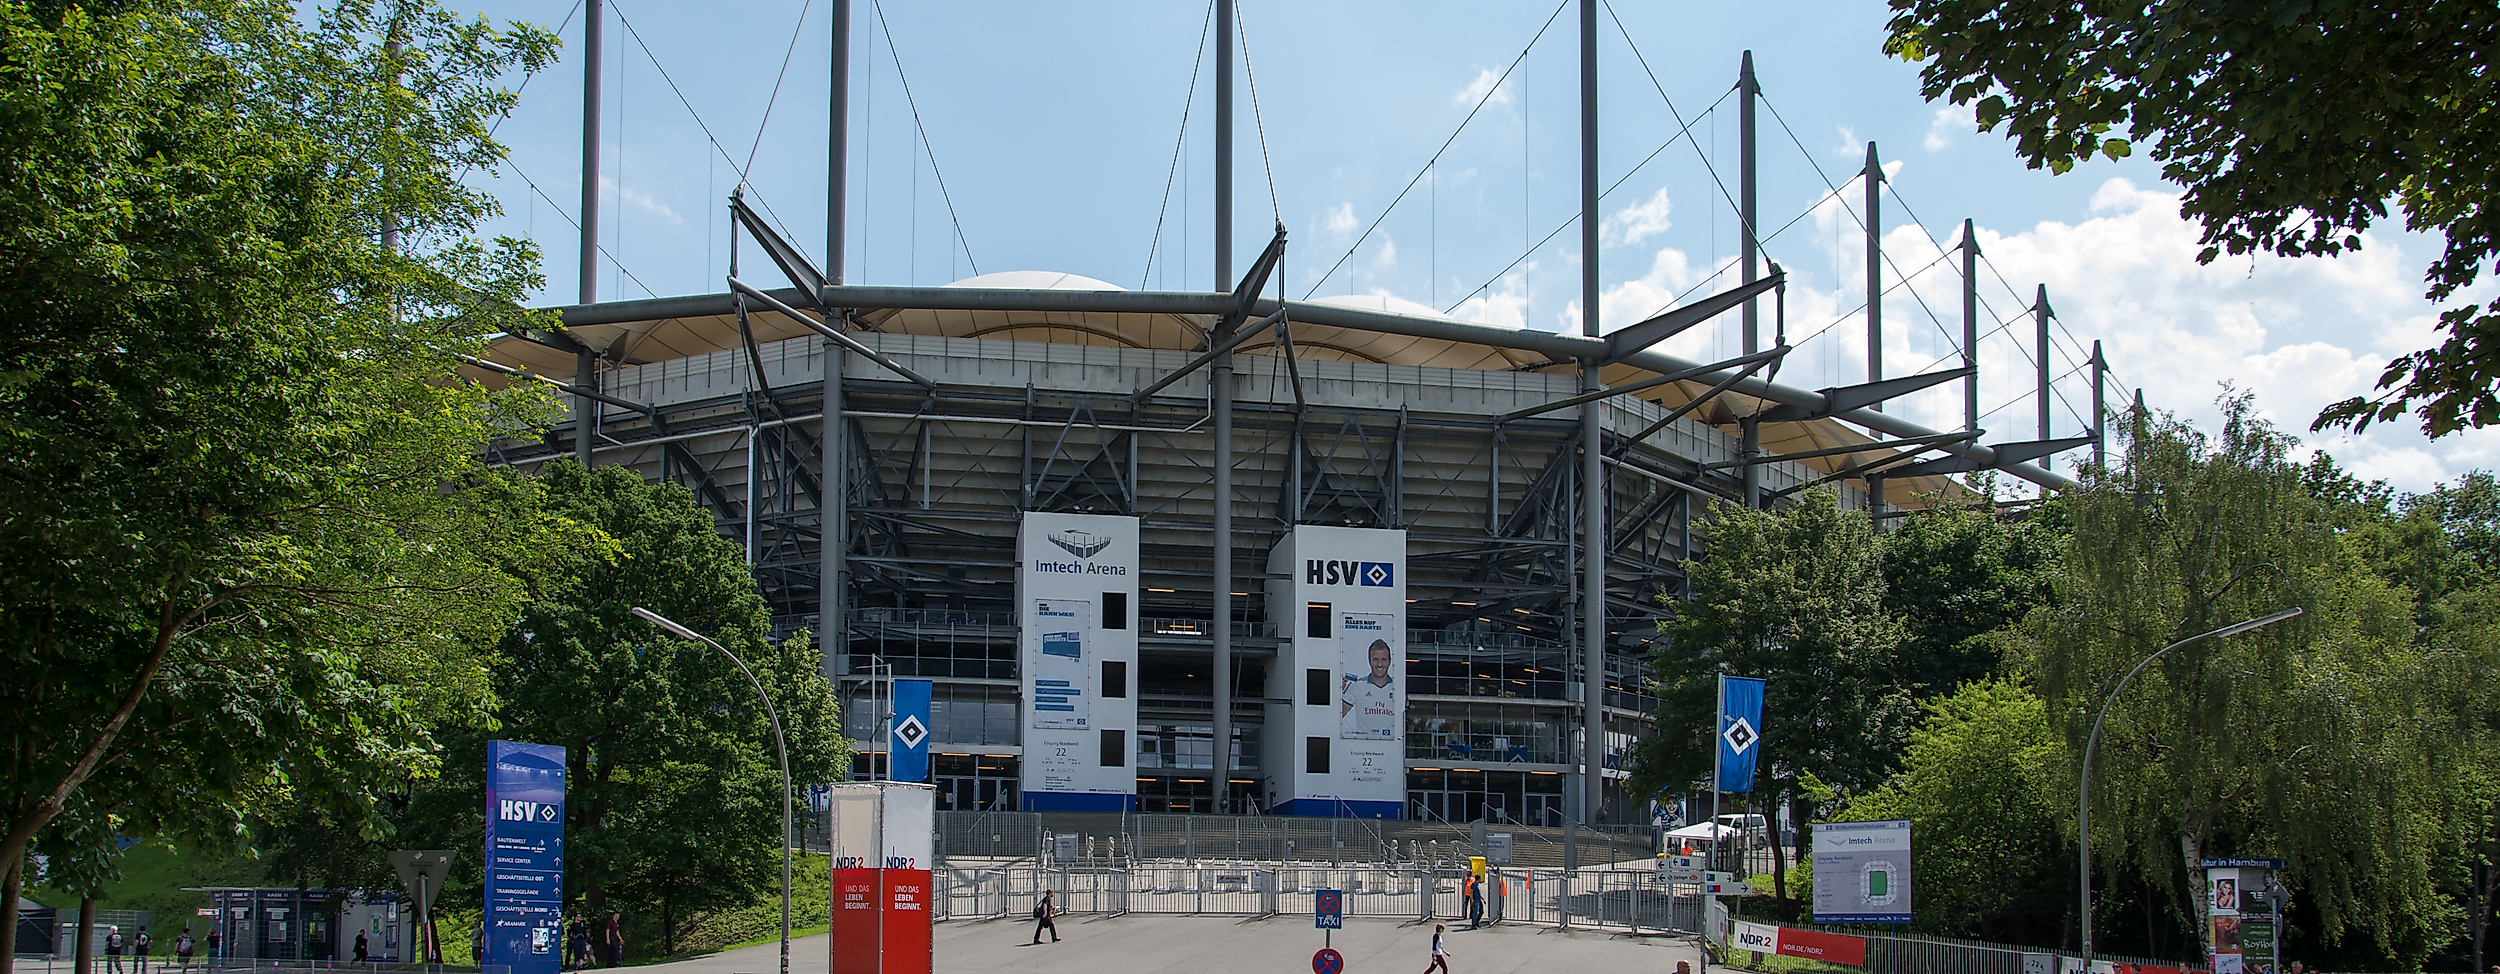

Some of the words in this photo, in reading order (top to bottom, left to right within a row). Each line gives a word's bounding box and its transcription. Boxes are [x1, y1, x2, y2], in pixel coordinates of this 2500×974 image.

[1036, 559, 1082, 574] Imtech
[1087, 561, 1127, 576] Arena
[1307, 559, 1359, 586] HSV
[1364, 707, 1394, 717] Emirates
[1056, 747, 1067, 757] 22
[1362, 757, 1372, 767] 22
[501, 799, 538, 823] HSV
[1848, 837, 1873, 845] Imtech
[2229, 859, 2271, 869] Hamburg
[908, 885, 920, 893] DAS
[845, 893, 864, 901] LEBEN
[845, 902, 871, 910] BEGINNT.
[894, 902, 922, 910] BEGINNT.
[503, 919, 527, 927] ARAMARK
[1318, 916, 1340, 926] TAXI
[1782, 943, 1824, 955] NDR.DE/NDR2
